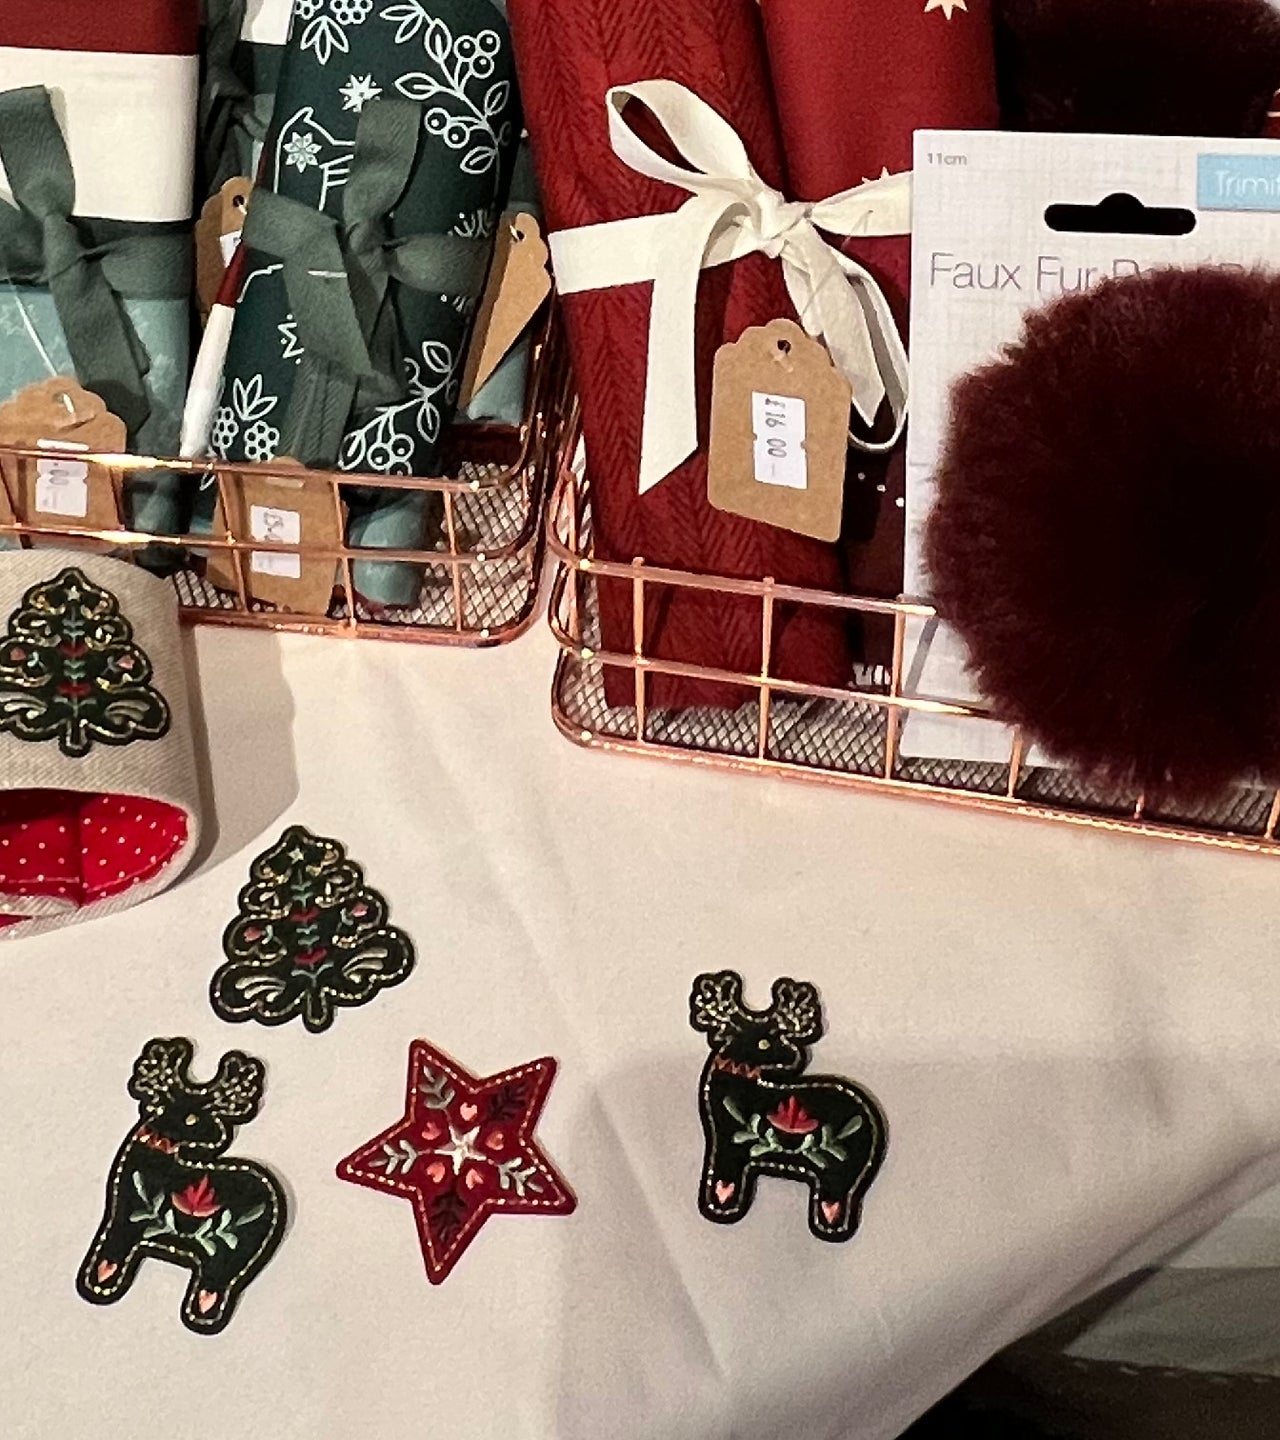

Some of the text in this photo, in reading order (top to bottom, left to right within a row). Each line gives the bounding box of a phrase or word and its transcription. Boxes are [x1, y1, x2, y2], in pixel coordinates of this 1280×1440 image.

[927, 152, 967, 166] 11cm
[930, 251, 1022, 291] Faux
[1036, 254, 1099, 293] Fur
